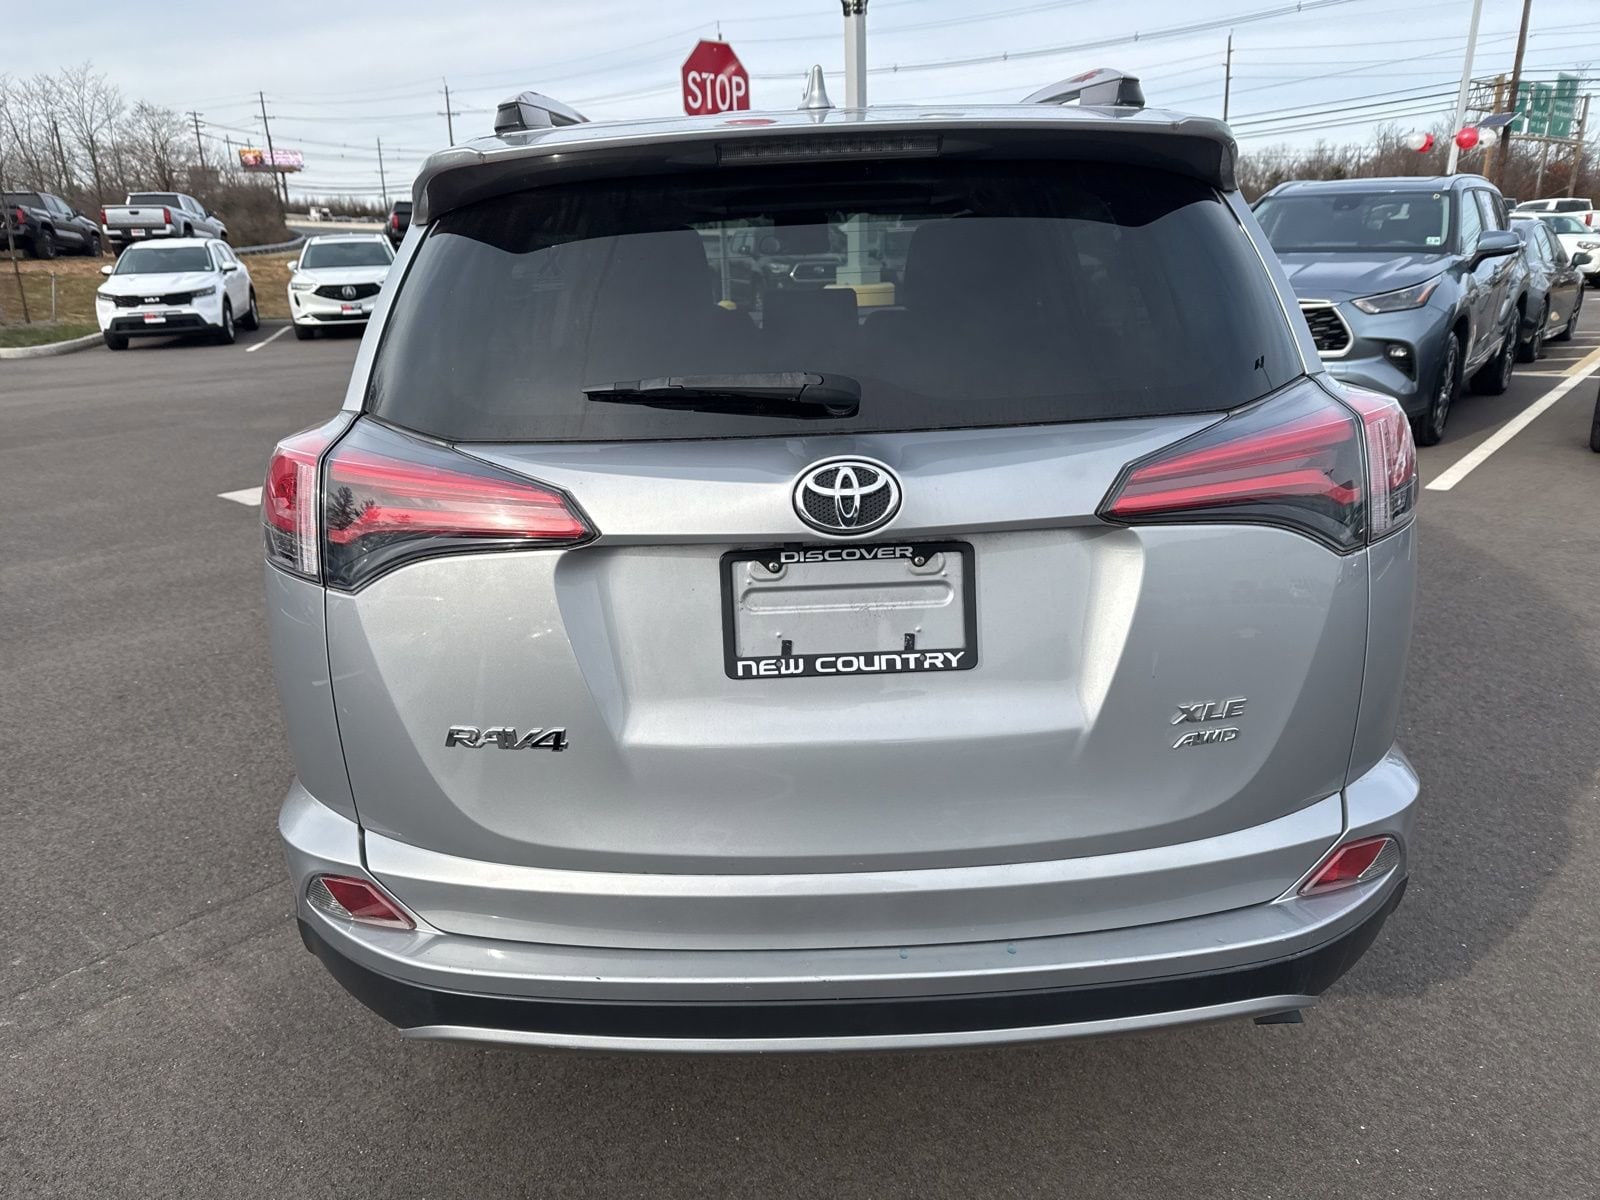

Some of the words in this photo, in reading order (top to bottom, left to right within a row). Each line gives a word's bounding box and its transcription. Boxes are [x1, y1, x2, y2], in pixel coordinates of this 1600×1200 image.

[687, 70, 746, 111] STOP
[780, 546, 914, 563] DISCOVER
[737, 657, 804, 676] NEW
[815, 651, 965, 673] COUNTRY
[1170, 696, 1248, 725] XLE
[445, 725, 569, 752] RAV4
[1172, 727, 1240, 750] AWD
